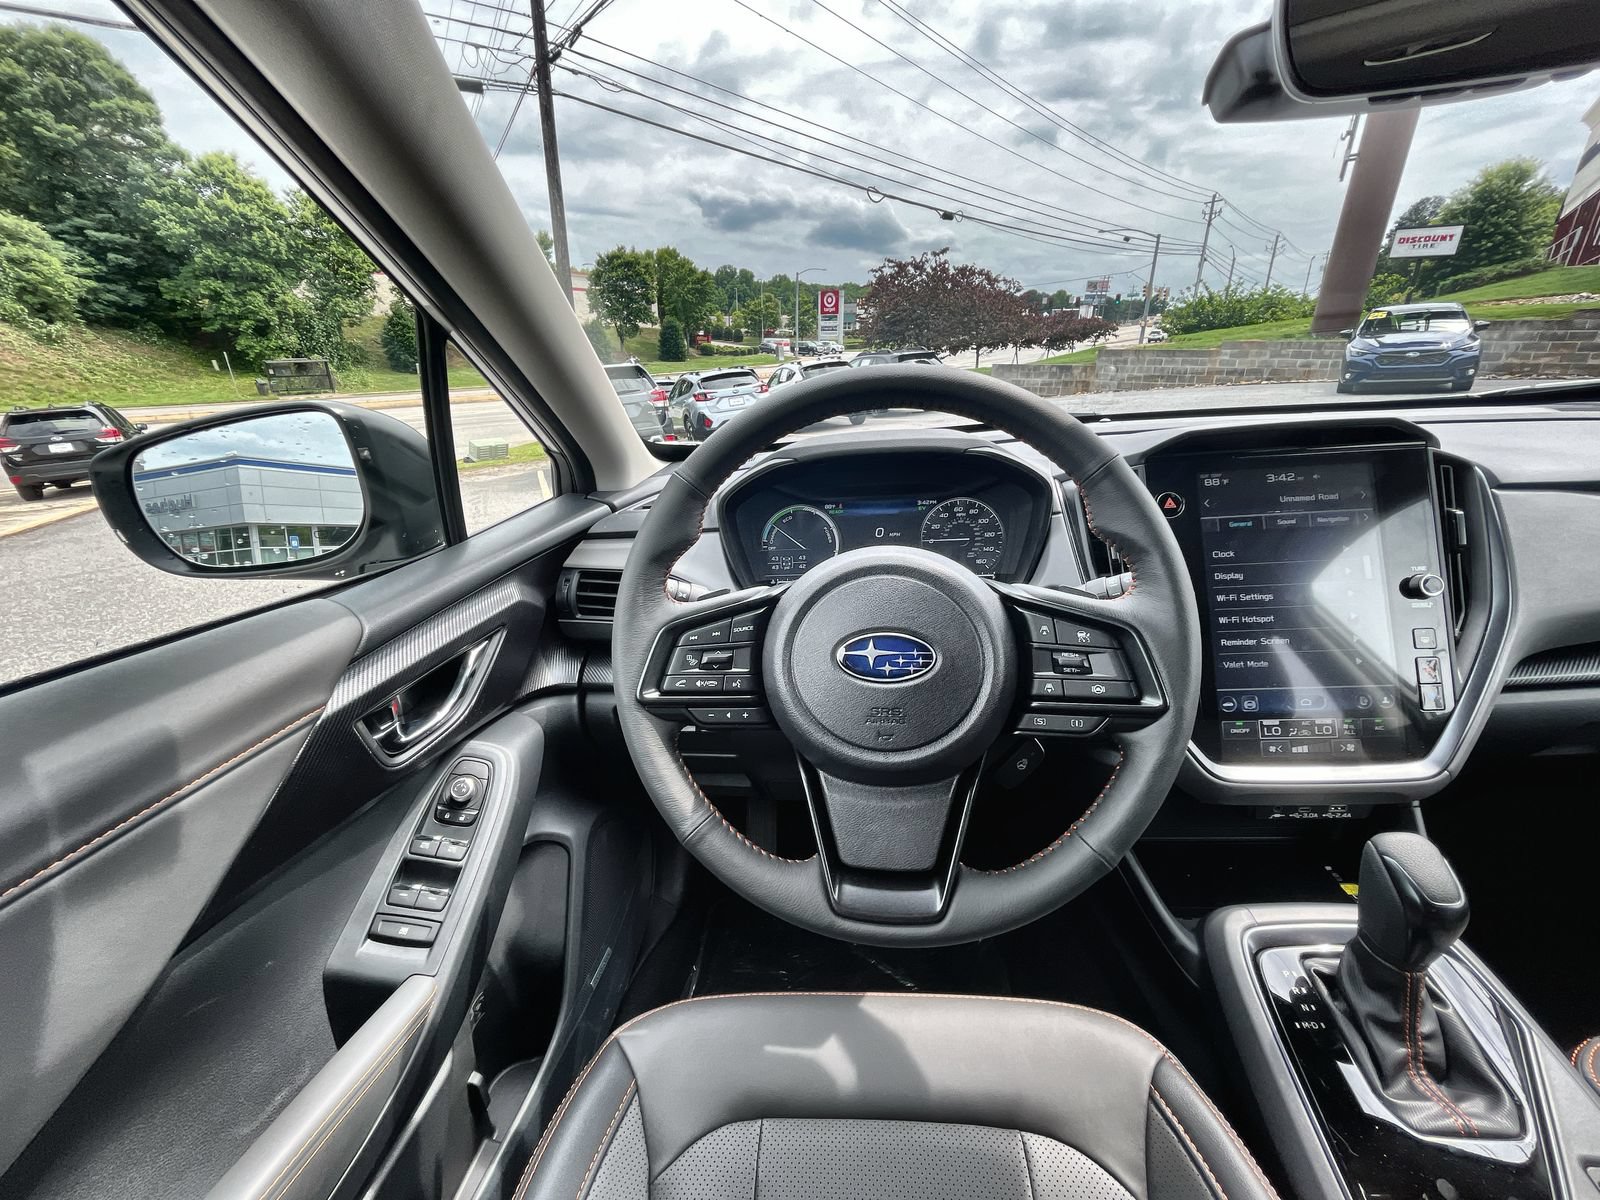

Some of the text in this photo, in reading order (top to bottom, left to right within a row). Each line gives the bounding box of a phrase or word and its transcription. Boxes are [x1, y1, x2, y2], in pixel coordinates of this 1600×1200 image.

[1398, 234, 1455, 244] DISCOUNT
[1265, 472, 1296, 483] 3:42
[1204, 478, 1221, 487] 88
[1279, 493, 1339, 503] Unnamed Road
[875, 527, 885, 538] 0
[1212, 550, 1235, 558] Clock
[1214, 573, 1244, 581] Display
[1216, 593, 1274, 602] Wi-Fi Settings
[1218, 615, 1275, 624] Wi-Fi Hotspot
[733, 625, 754, 633] SOURCE
[1260, 637, 1290, 645] Screen
[1222, 660, 1270, 669] Valet Mode
[1263, 727, 1282, 736] LO
[1314, 725, 1333, 735] LO
